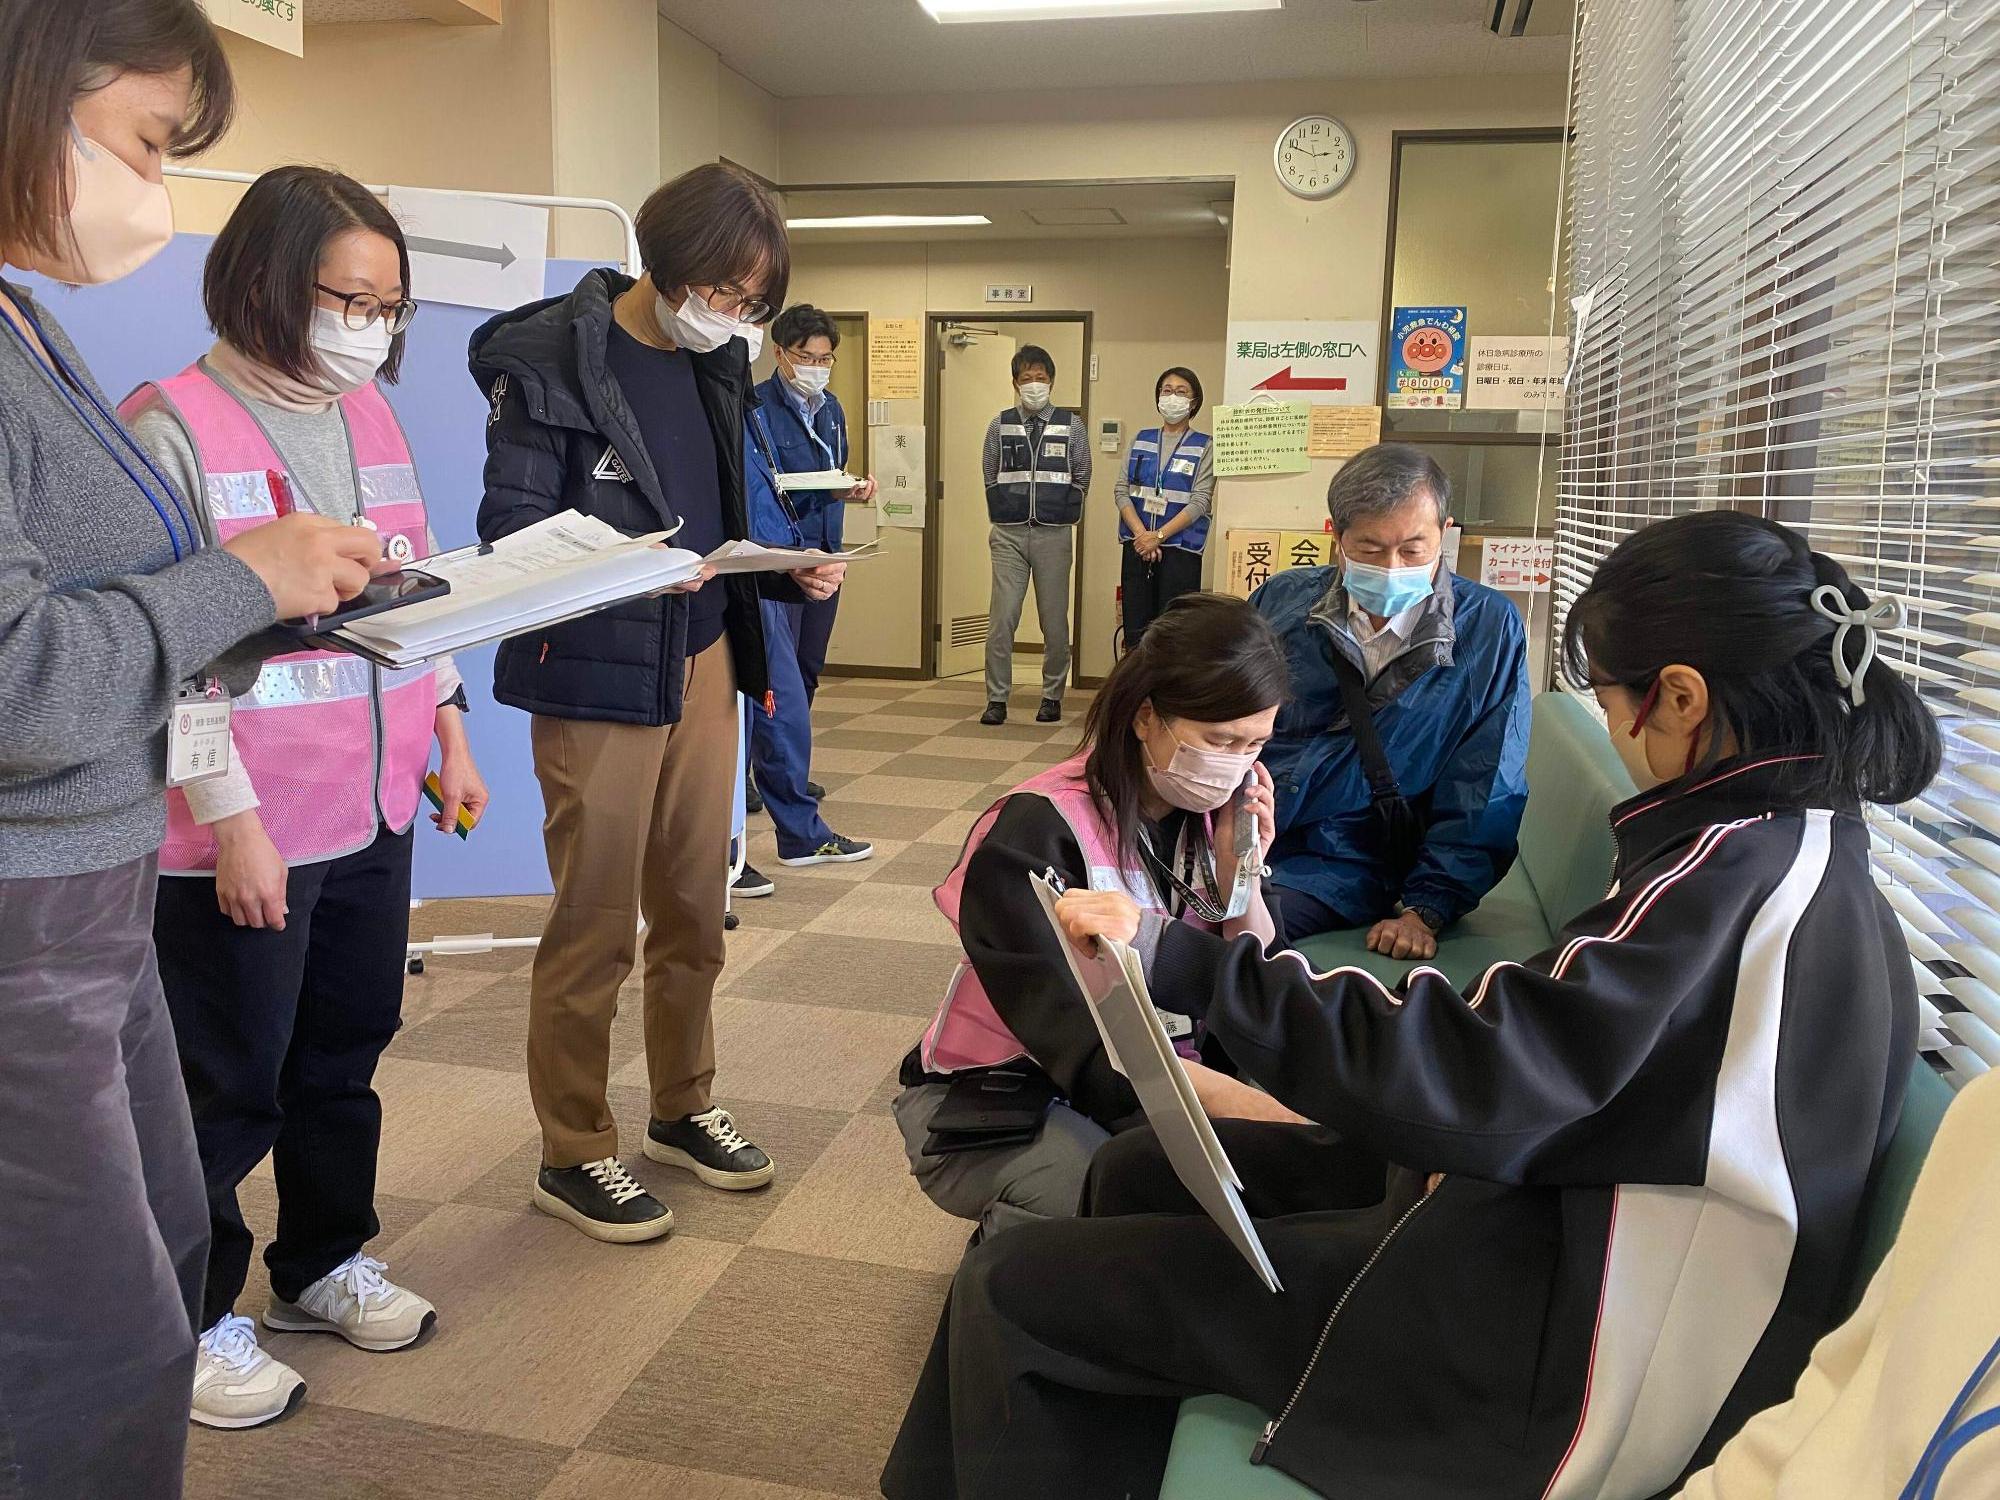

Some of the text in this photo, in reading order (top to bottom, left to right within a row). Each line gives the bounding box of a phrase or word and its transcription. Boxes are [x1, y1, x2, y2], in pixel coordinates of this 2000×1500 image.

[1299, 128, 1306, 138] 11
[1311, 124, 1320, 135] 12
[1289, 139, 1298, 148] 10
[1334, 137, 1341, 147] 2
[1285, 153, 1292, 162] 9
[1338, 150, 1344, 160] 3
[1289, 166, 1296, 176] 8
[1298, 175, 1304, 185] 7
[1310, 177, 1317, 187] 6
[1323, 175, 1329, 184] 5
[992, 289, 1026, 298] 事務室
[1237, 341, 1367, 359] 薬局は左側の窓口へ
[1478, 349, 1543, 358] 休日急病診療所の
[1399, 379, 1451, 387] #8000
[895, 435, 907, 488] 薬局
[611, 458, 629, 484] GATES
[1291, 539, 1320, 567] 会
[1490, 543, 1553, 554] マイナンバー
[1245, 541, 1272, 591] 受付
[1488, 558, 1552, 569] カードで受付
